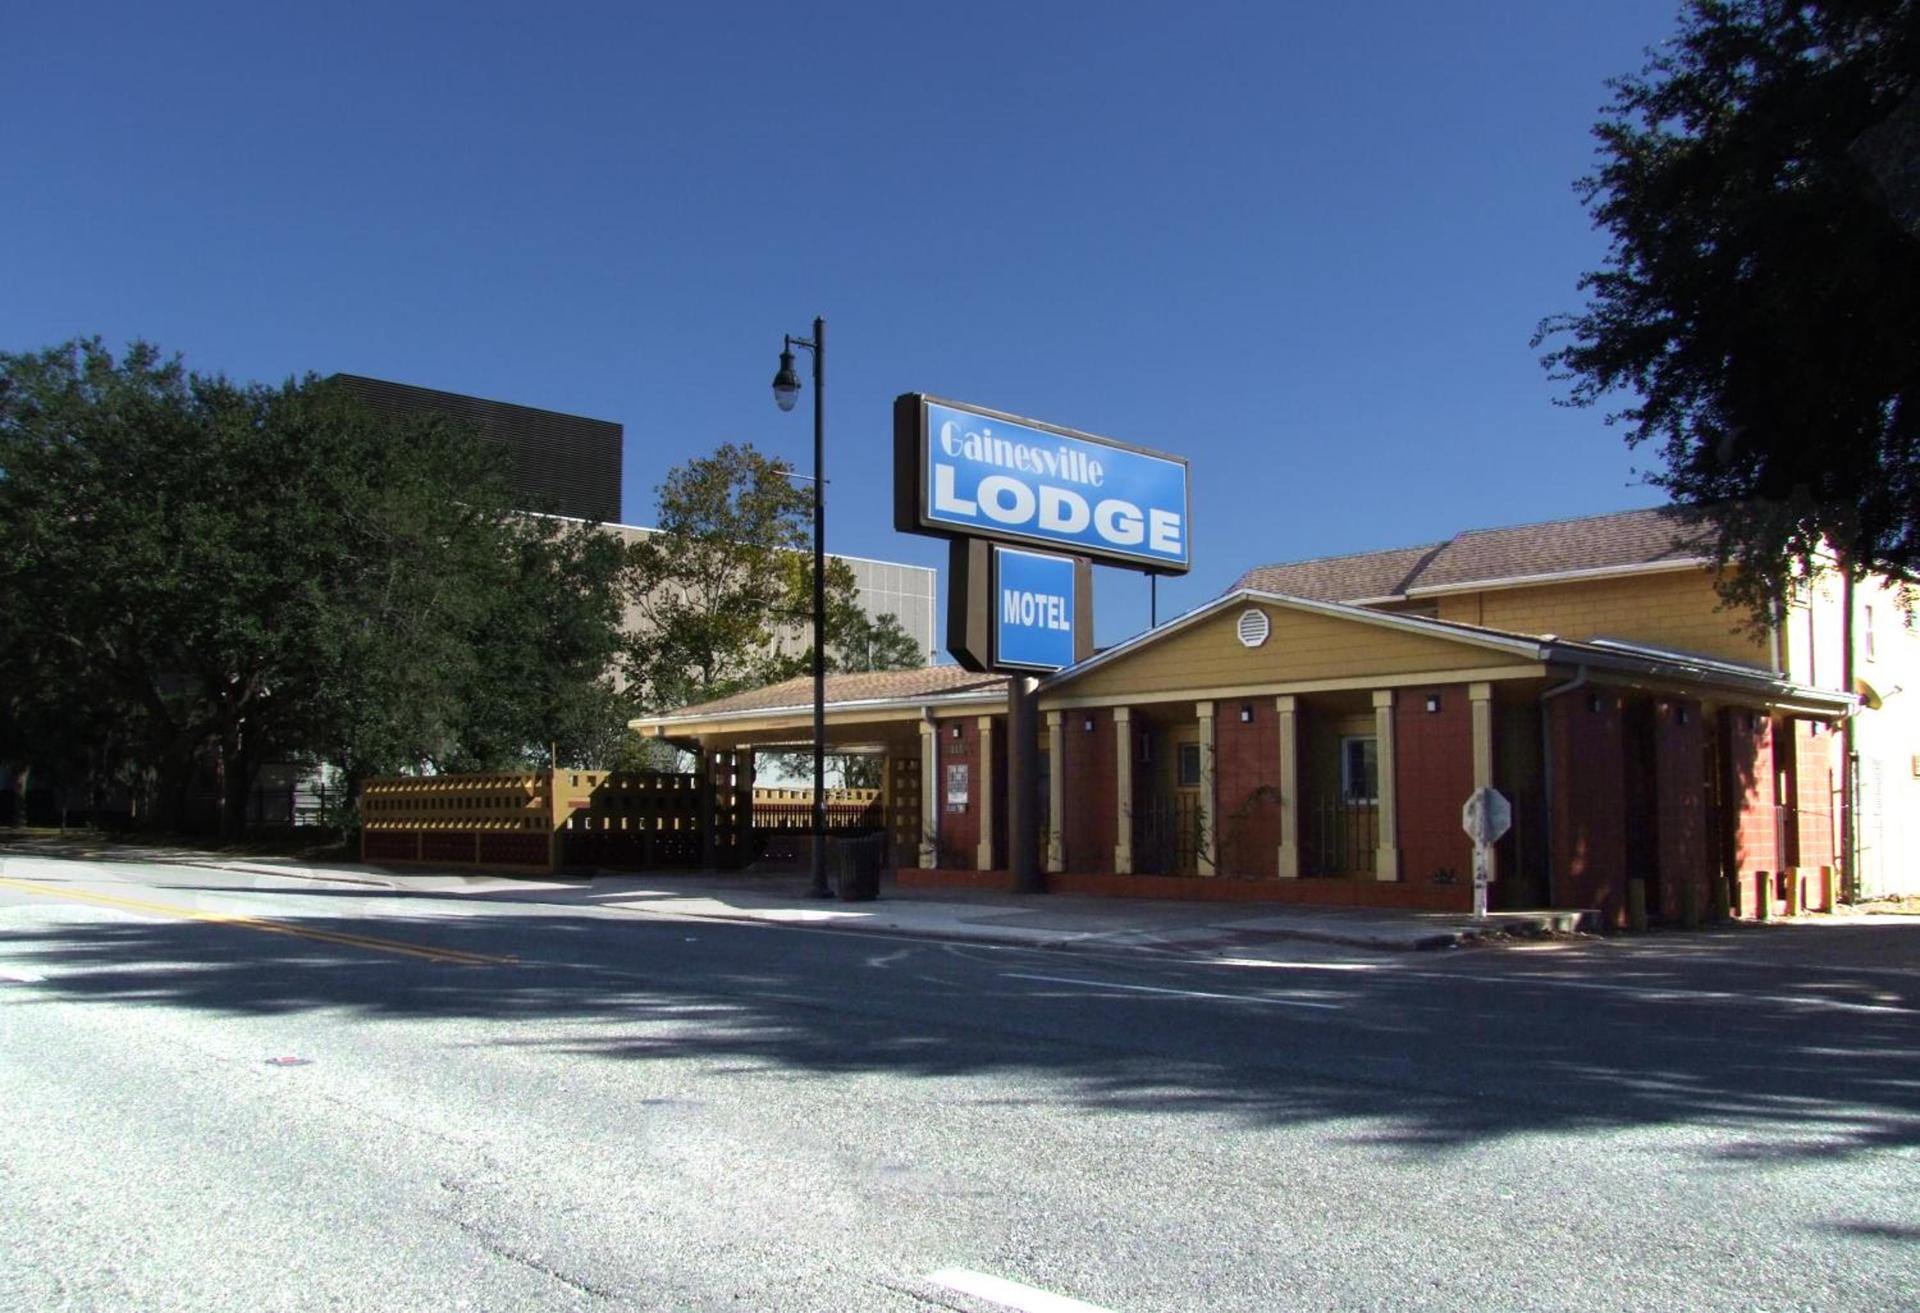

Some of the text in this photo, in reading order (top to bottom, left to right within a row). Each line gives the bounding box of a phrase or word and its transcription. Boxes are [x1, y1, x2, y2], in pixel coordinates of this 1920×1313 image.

[940, 420, 1104, 488] Gainesville
[935, 463, 1182, 554] LODGE
[1004, 588, 1070, 631] MOTEL
